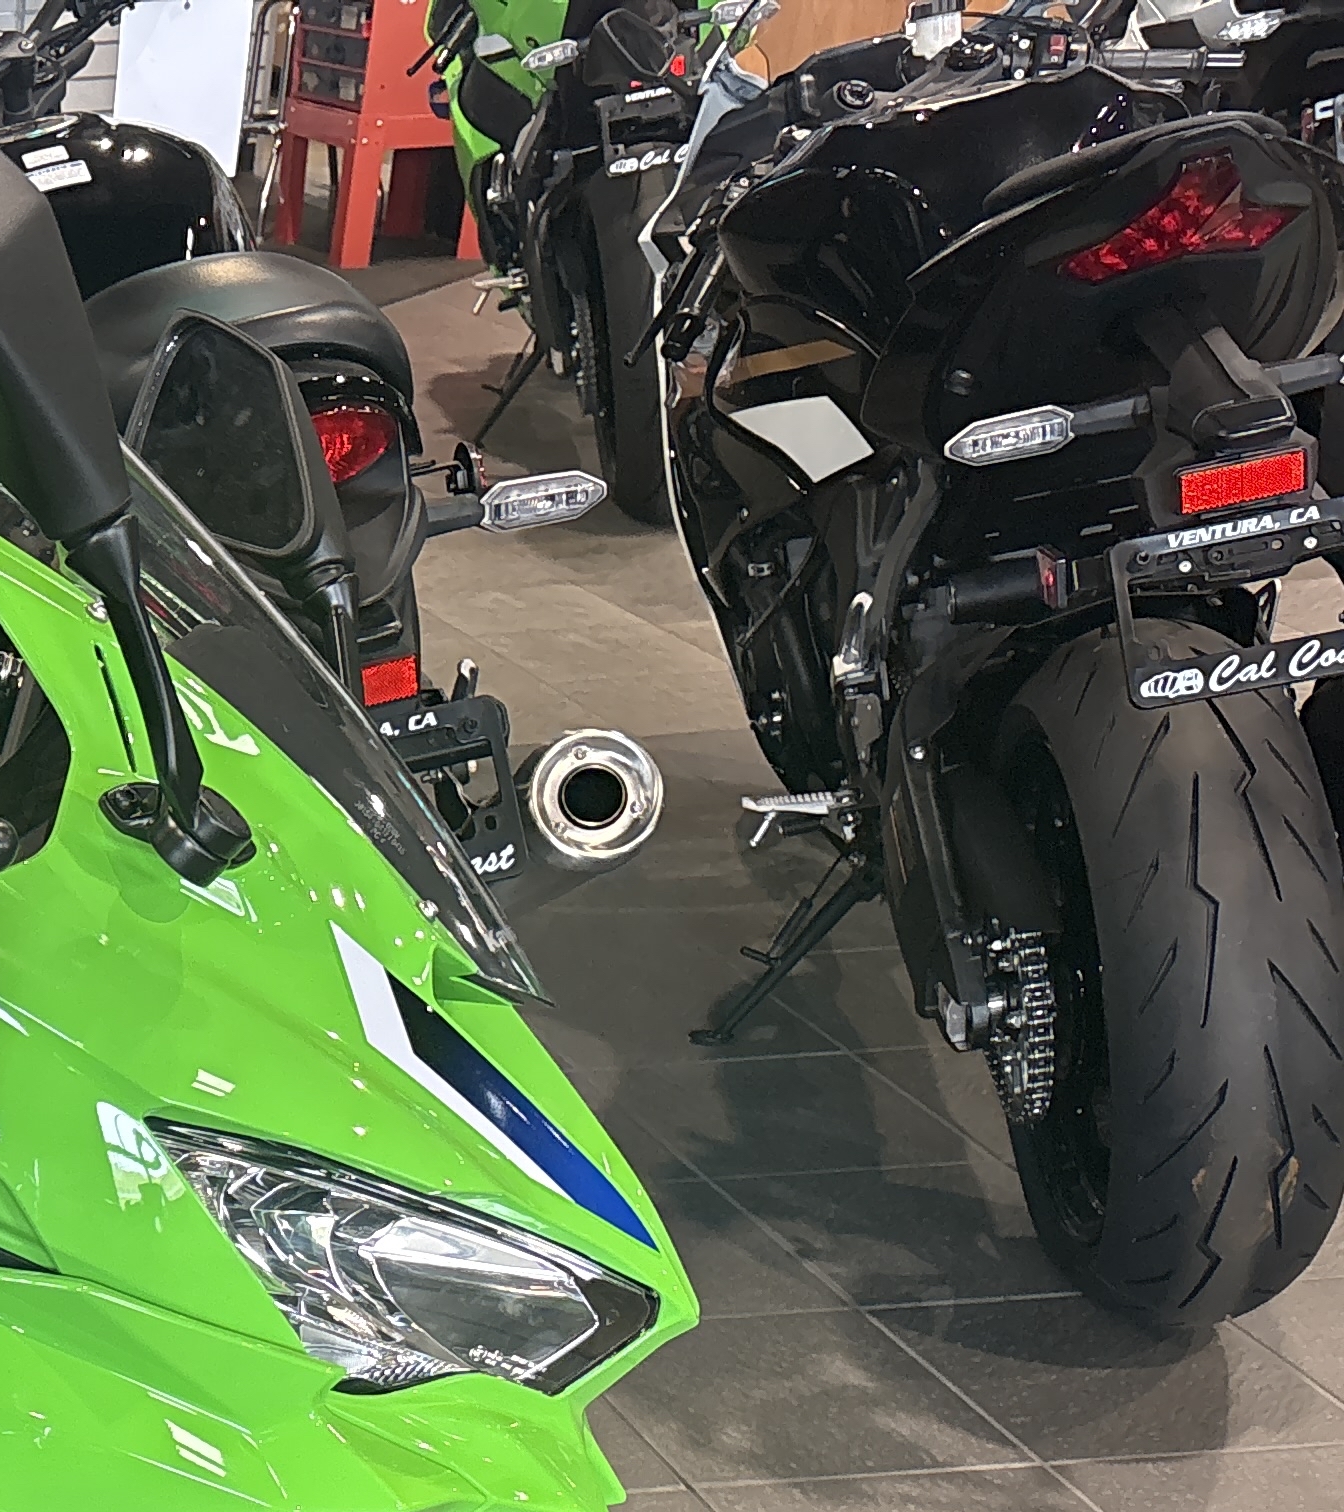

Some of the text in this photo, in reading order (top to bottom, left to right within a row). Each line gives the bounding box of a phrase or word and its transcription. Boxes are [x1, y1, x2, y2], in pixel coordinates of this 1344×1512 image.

[1167, 505, 1320, 548] VENTURA, CA
[1209, 650, 1276, 692] Cal
[408, 711, 438, 731] CA
